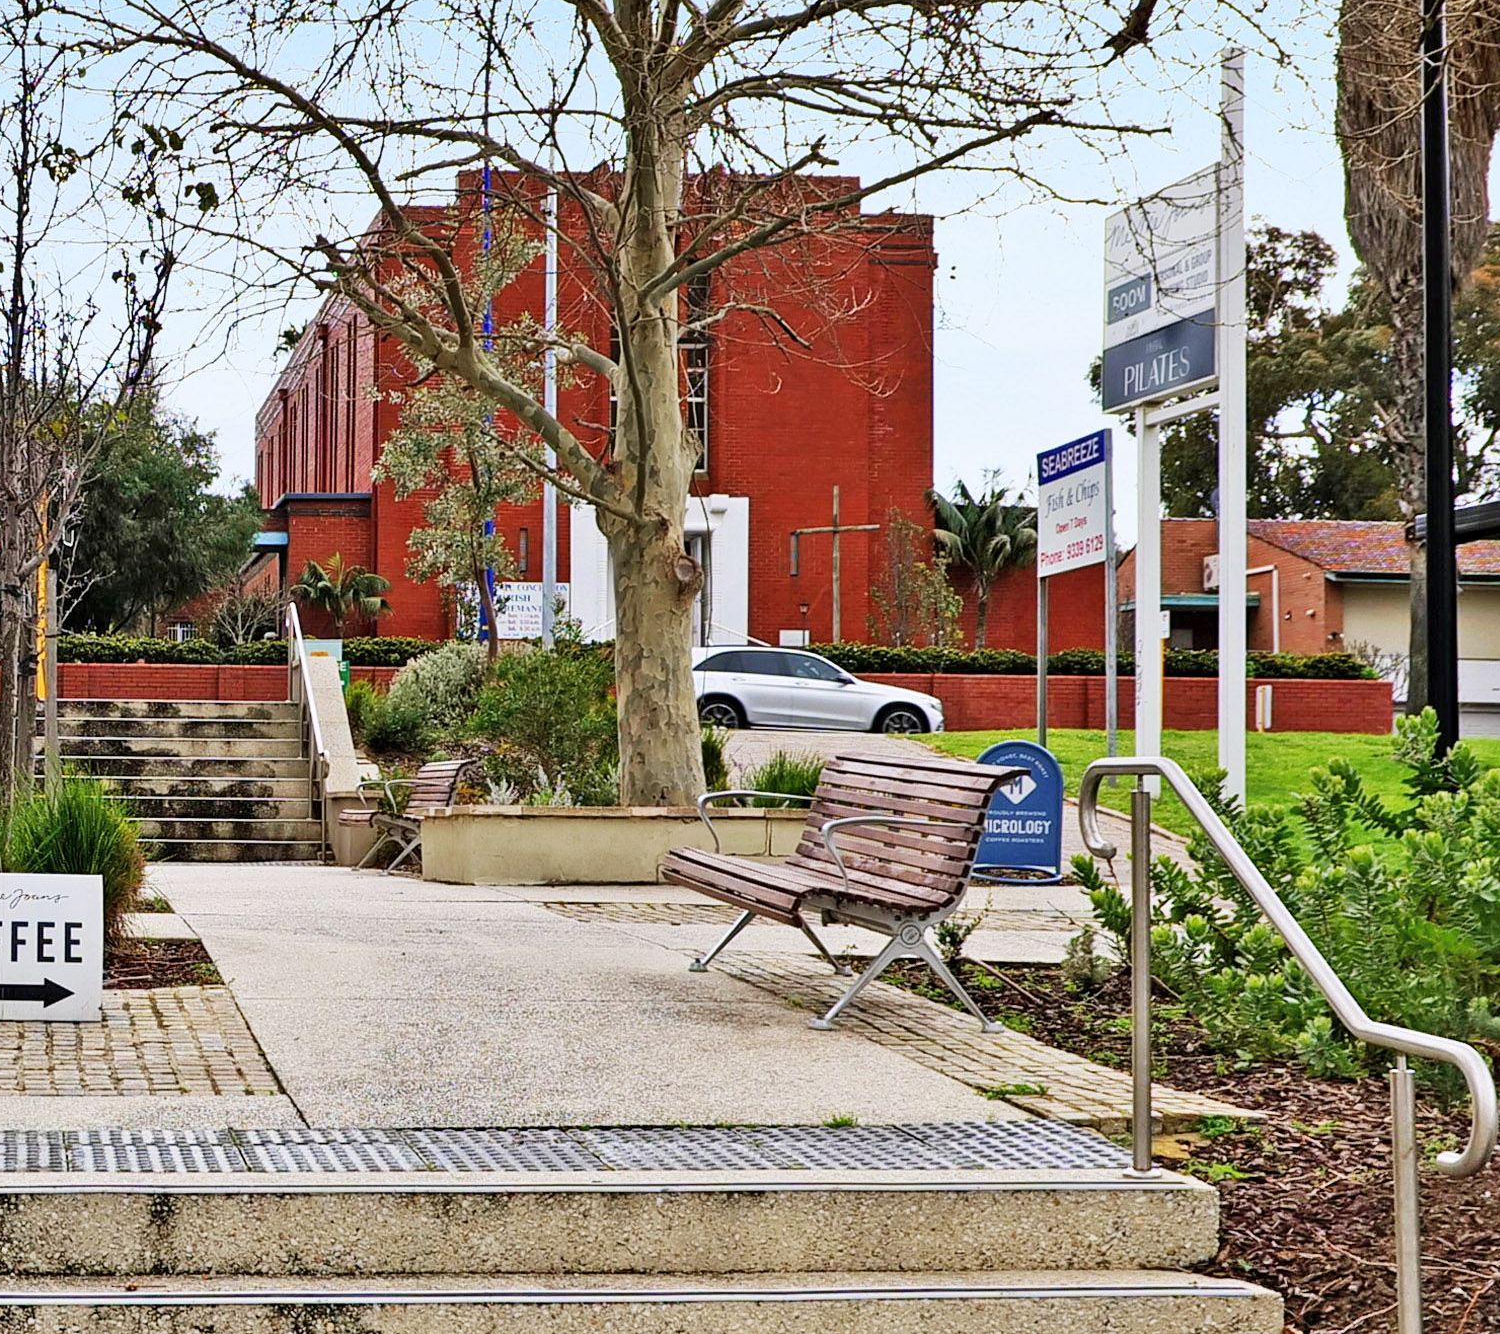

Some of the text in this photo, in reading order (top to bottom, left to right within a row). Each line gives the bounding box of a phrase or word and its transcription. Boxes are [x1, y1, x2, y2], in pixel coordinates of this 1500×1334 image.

[1123, 346, 1191, 397] PILATES
[1041, 436, 1100, 478] SEABREEZE
[1045, 478, 1101, 518] Fish & Chips
[1040, 549, 1065, 568] Phone:
